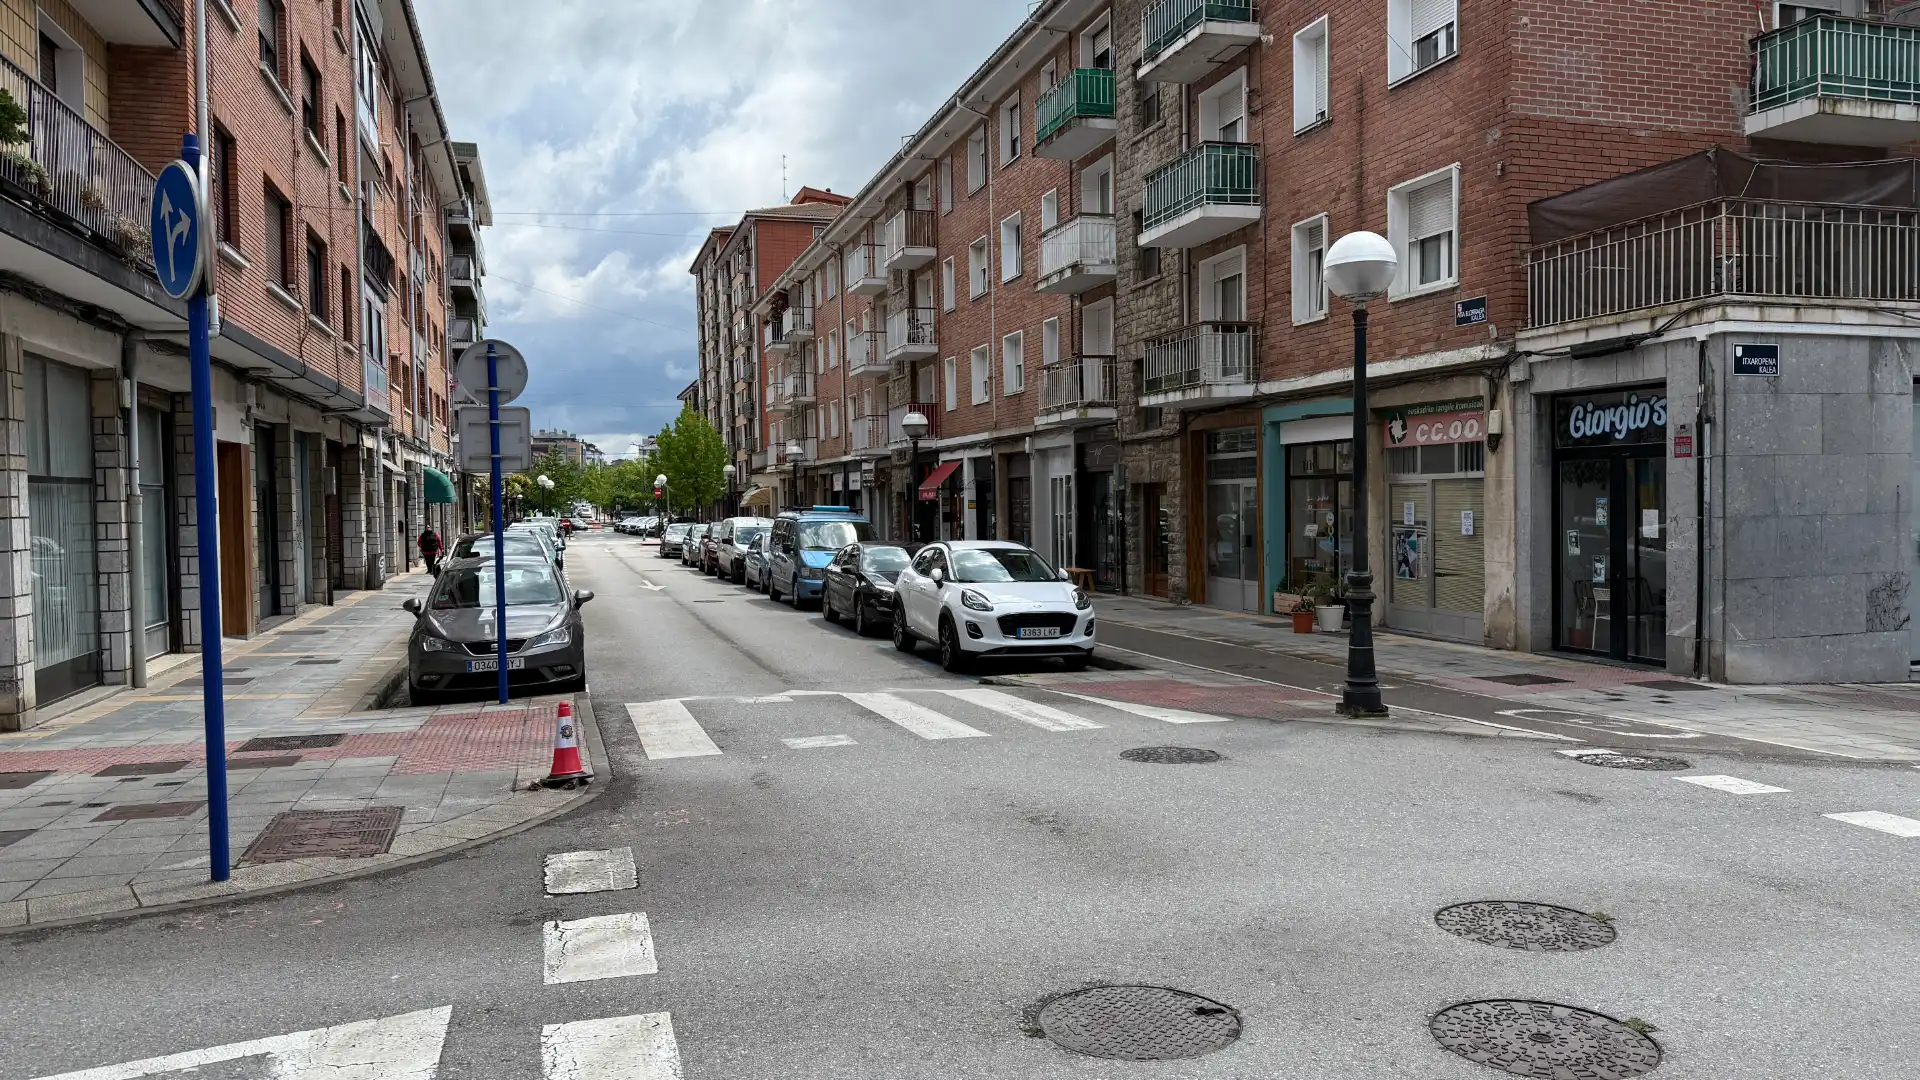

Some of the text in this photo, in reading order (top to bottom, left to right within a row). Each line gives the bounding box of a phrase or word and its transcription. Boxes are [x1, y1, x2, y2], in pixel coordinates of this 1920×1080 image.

[1471, 313, 1485, 321] KALEA
[1742, 357, 1776, 366] ITXAROPENA
[1759, 366, 1776, 374] KALEA
[1569, 393, 1668, 440] Giorgio's
[1415, 417, 1483, 443] CC.OO.
[1022, 628, 1058, 637] 3363 LKF
[474, 660, 498, 671] 0340
